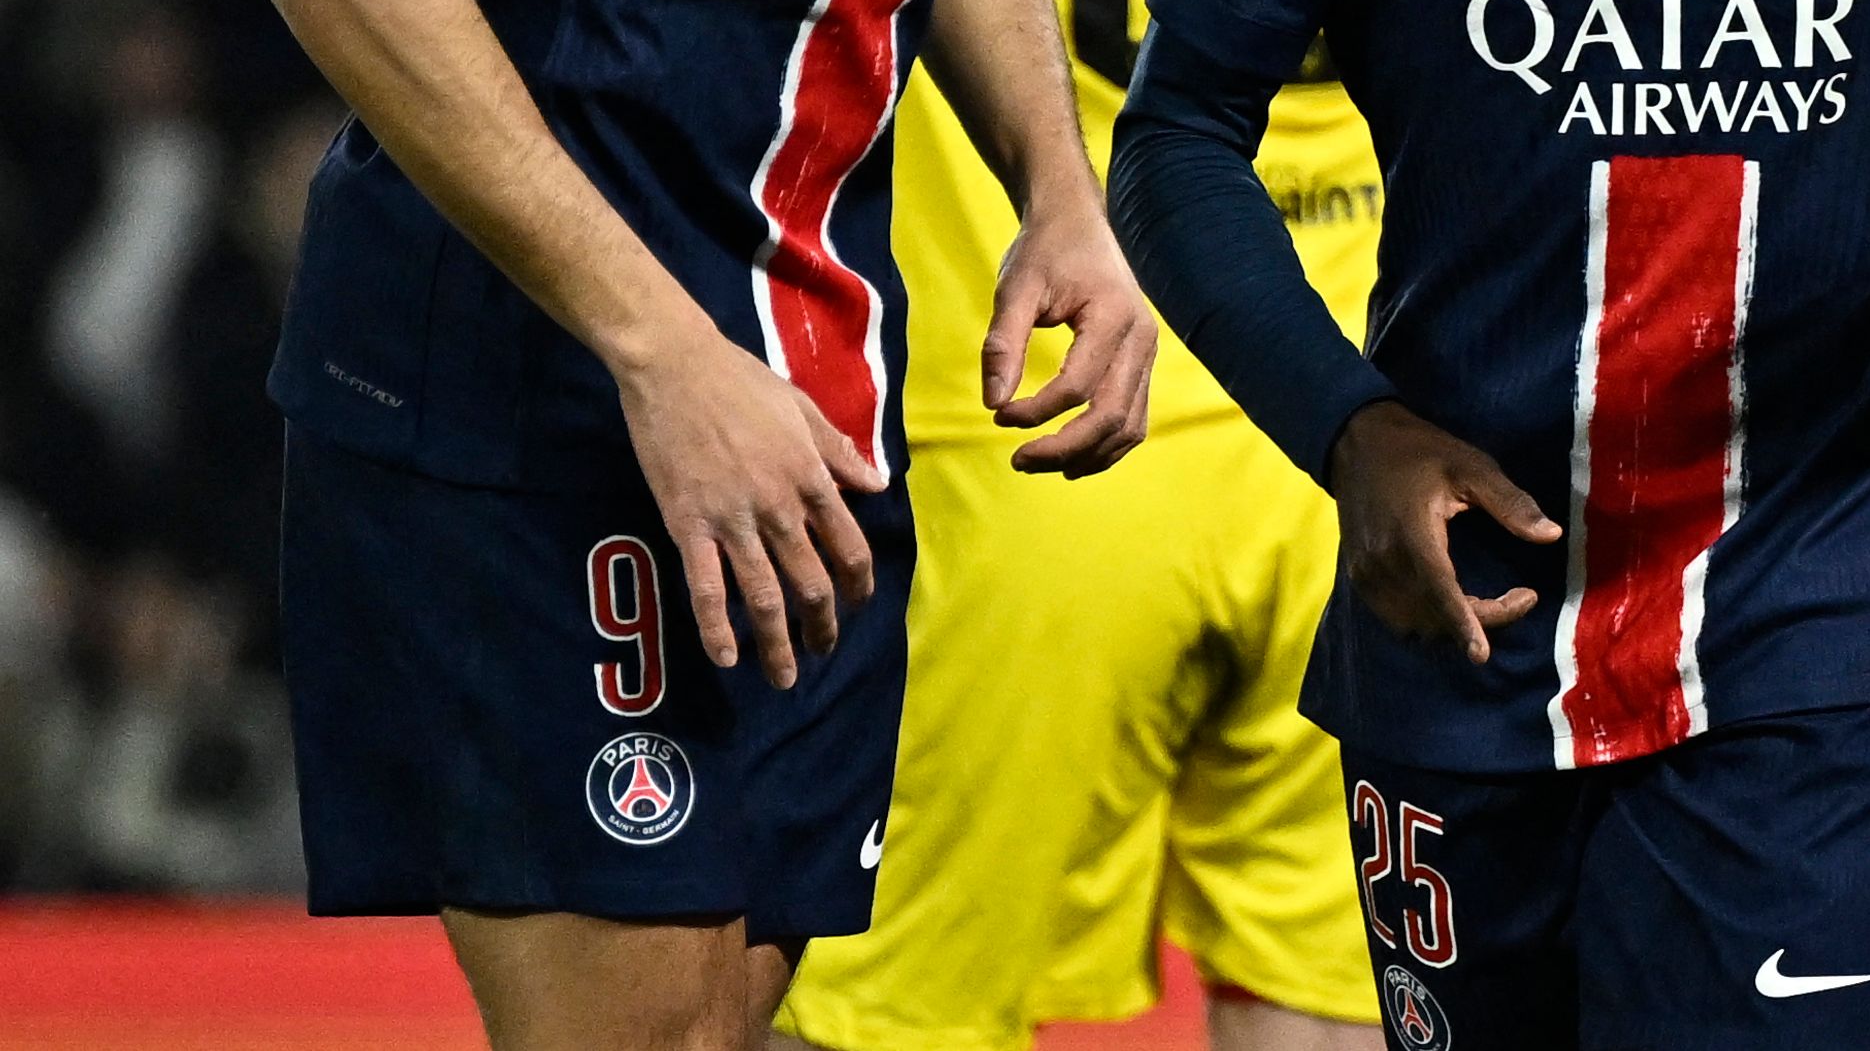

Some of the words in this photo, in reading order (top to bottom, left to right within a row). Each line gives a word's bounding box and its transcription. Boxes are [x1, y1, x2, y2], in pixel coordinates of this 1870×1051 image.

[1557, 71, 1847, 136] AIRWAYS
[586, 534, 667, 718] 9
[602, 738, 675, 768] PARIS
[607, 814, 635, 834] SAINT
[642, 809, 680, 835] GERMAIN
[1353, 779, 1458, 969] 25
[1387, 970, 1427, 1001] PARIS
